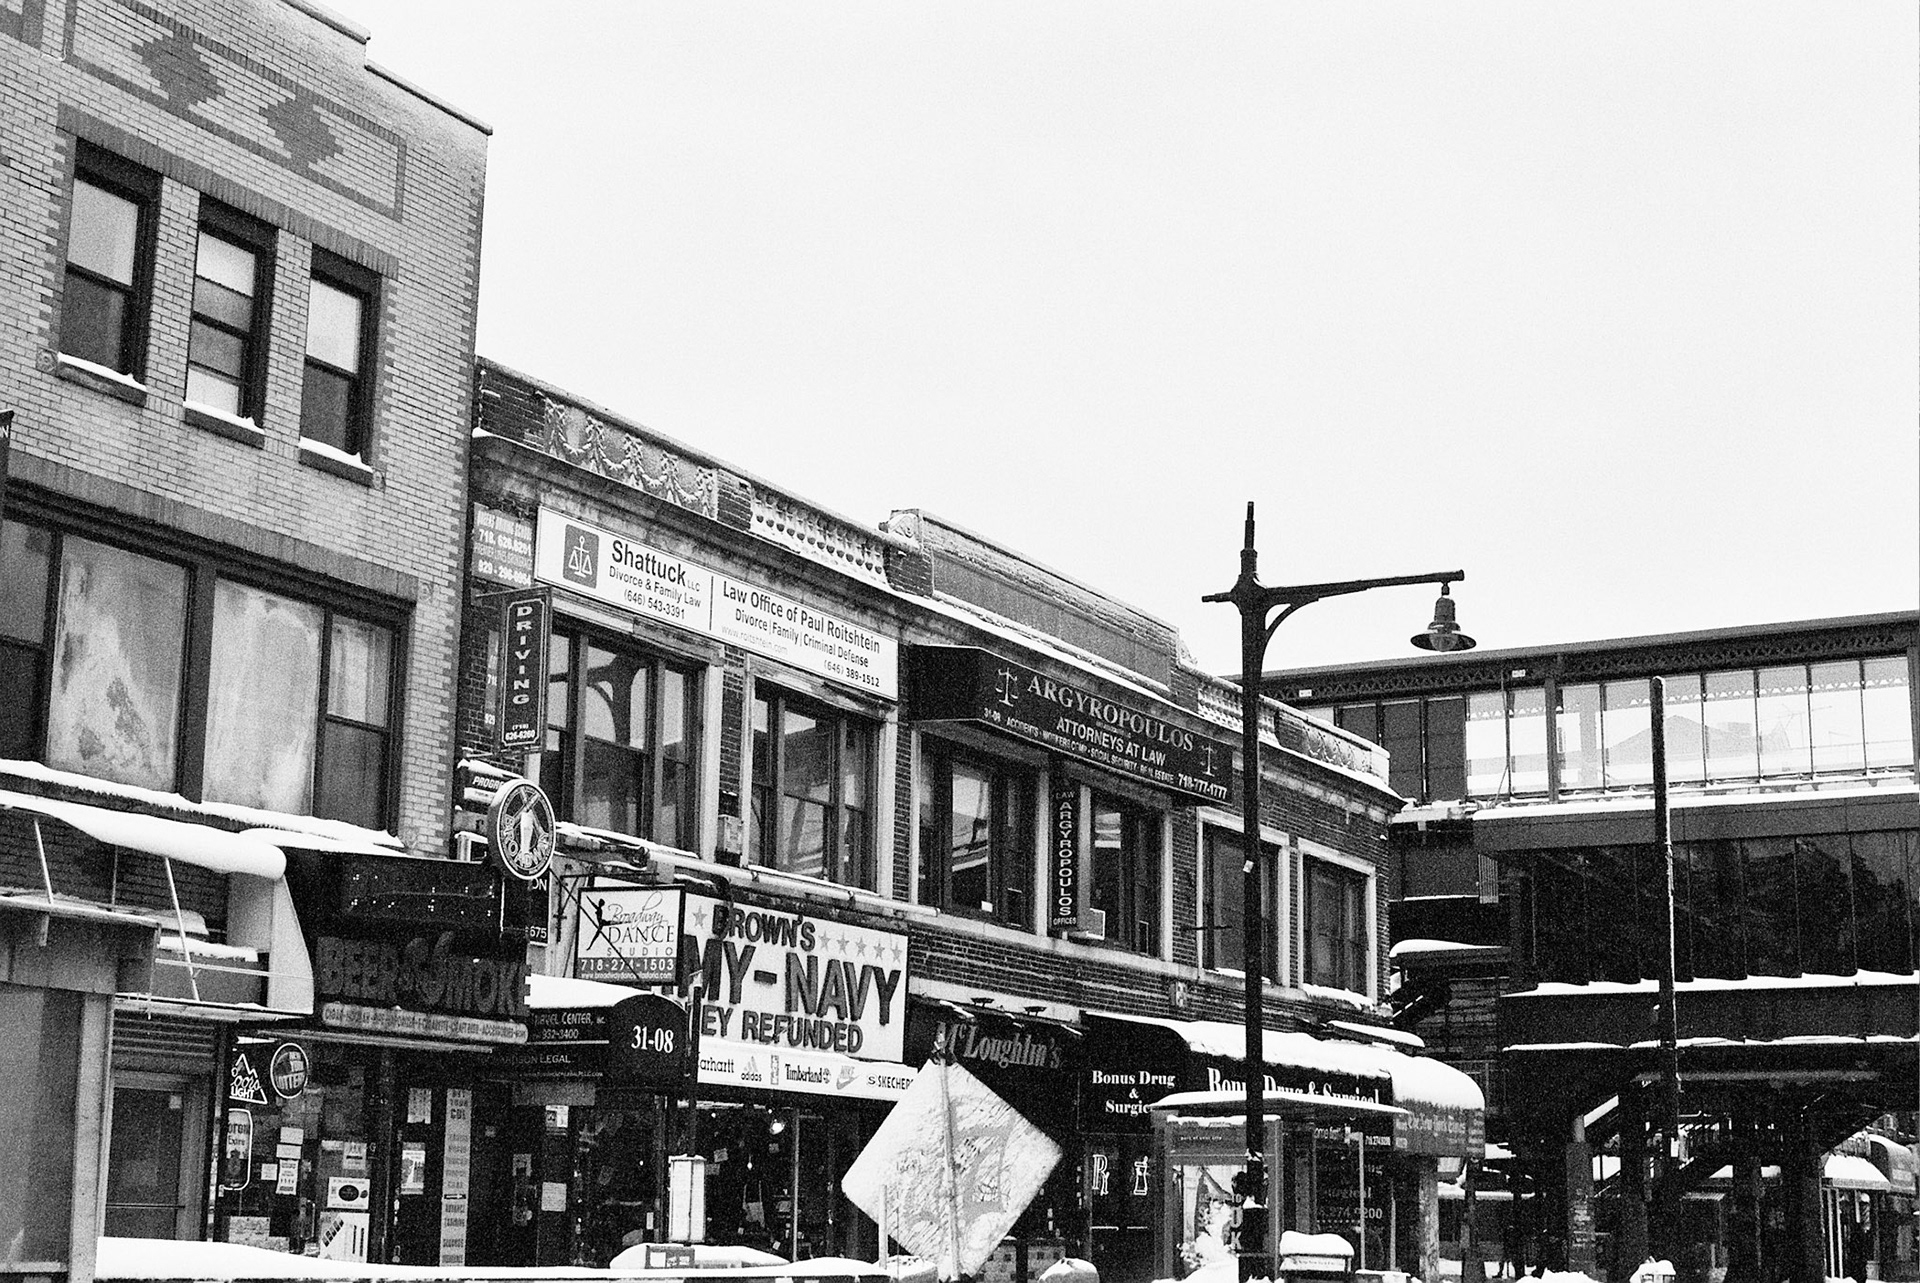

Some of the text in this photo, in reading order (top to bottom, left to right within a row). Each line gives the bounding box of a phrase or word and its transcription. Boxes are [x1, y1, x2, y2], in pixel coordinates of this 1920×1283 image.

[612, 540, 701, 592] Shattuck LLC
[609, 565, 702, 608] Divorce & Family Law
[624, 588, 685, 620] (646) 543-3391
[723, 580, 881, 654] Law Office of Paul Roitshtein
[735, 608, 869, 668] Divorce Family Criminal Defense
[512, 606, 533, 705] DRIVING
[824, 659, 880, 688] (646) 389-1512
[1027, 675, 1194, 752] ARGYROPOULOS
[1057, 716, 1124, 753] ATTORNEYS
[1125, 741, 1140, 758] AT
[1142, 746, 1167, 766] LAW
[1055, 791, 1076, 800] LAW
[1058, 801, 1073, 916] ARGYROPOULOS
[608, 924, 675, 944] DANCE
[711, 904, 816, 952] BROWN'S
[1053, 917, 1077, 926] OFFICES
[606, 946, 674, 957] STUDIO
[316, 936, 398, 1001] BEER
[631, 1025, 674, 1053] 31-08
[741, 1010, 864, 1054] REFUNDED
[540, 1054, 572, 1065] LEGAL
[698, 1056, 735, 1074] arhartt
[785, 1063, 823, 1084] Timberland
[740, 1072, 763, 1082] adidas
[1092, 1070, 1176, 1088] Bonus Drug
[230, 1085, 255, 1101] LIGHT
[1128, 1087, 1139, 1099] &
[1105, 1099, 1152, 1117] Surgic
